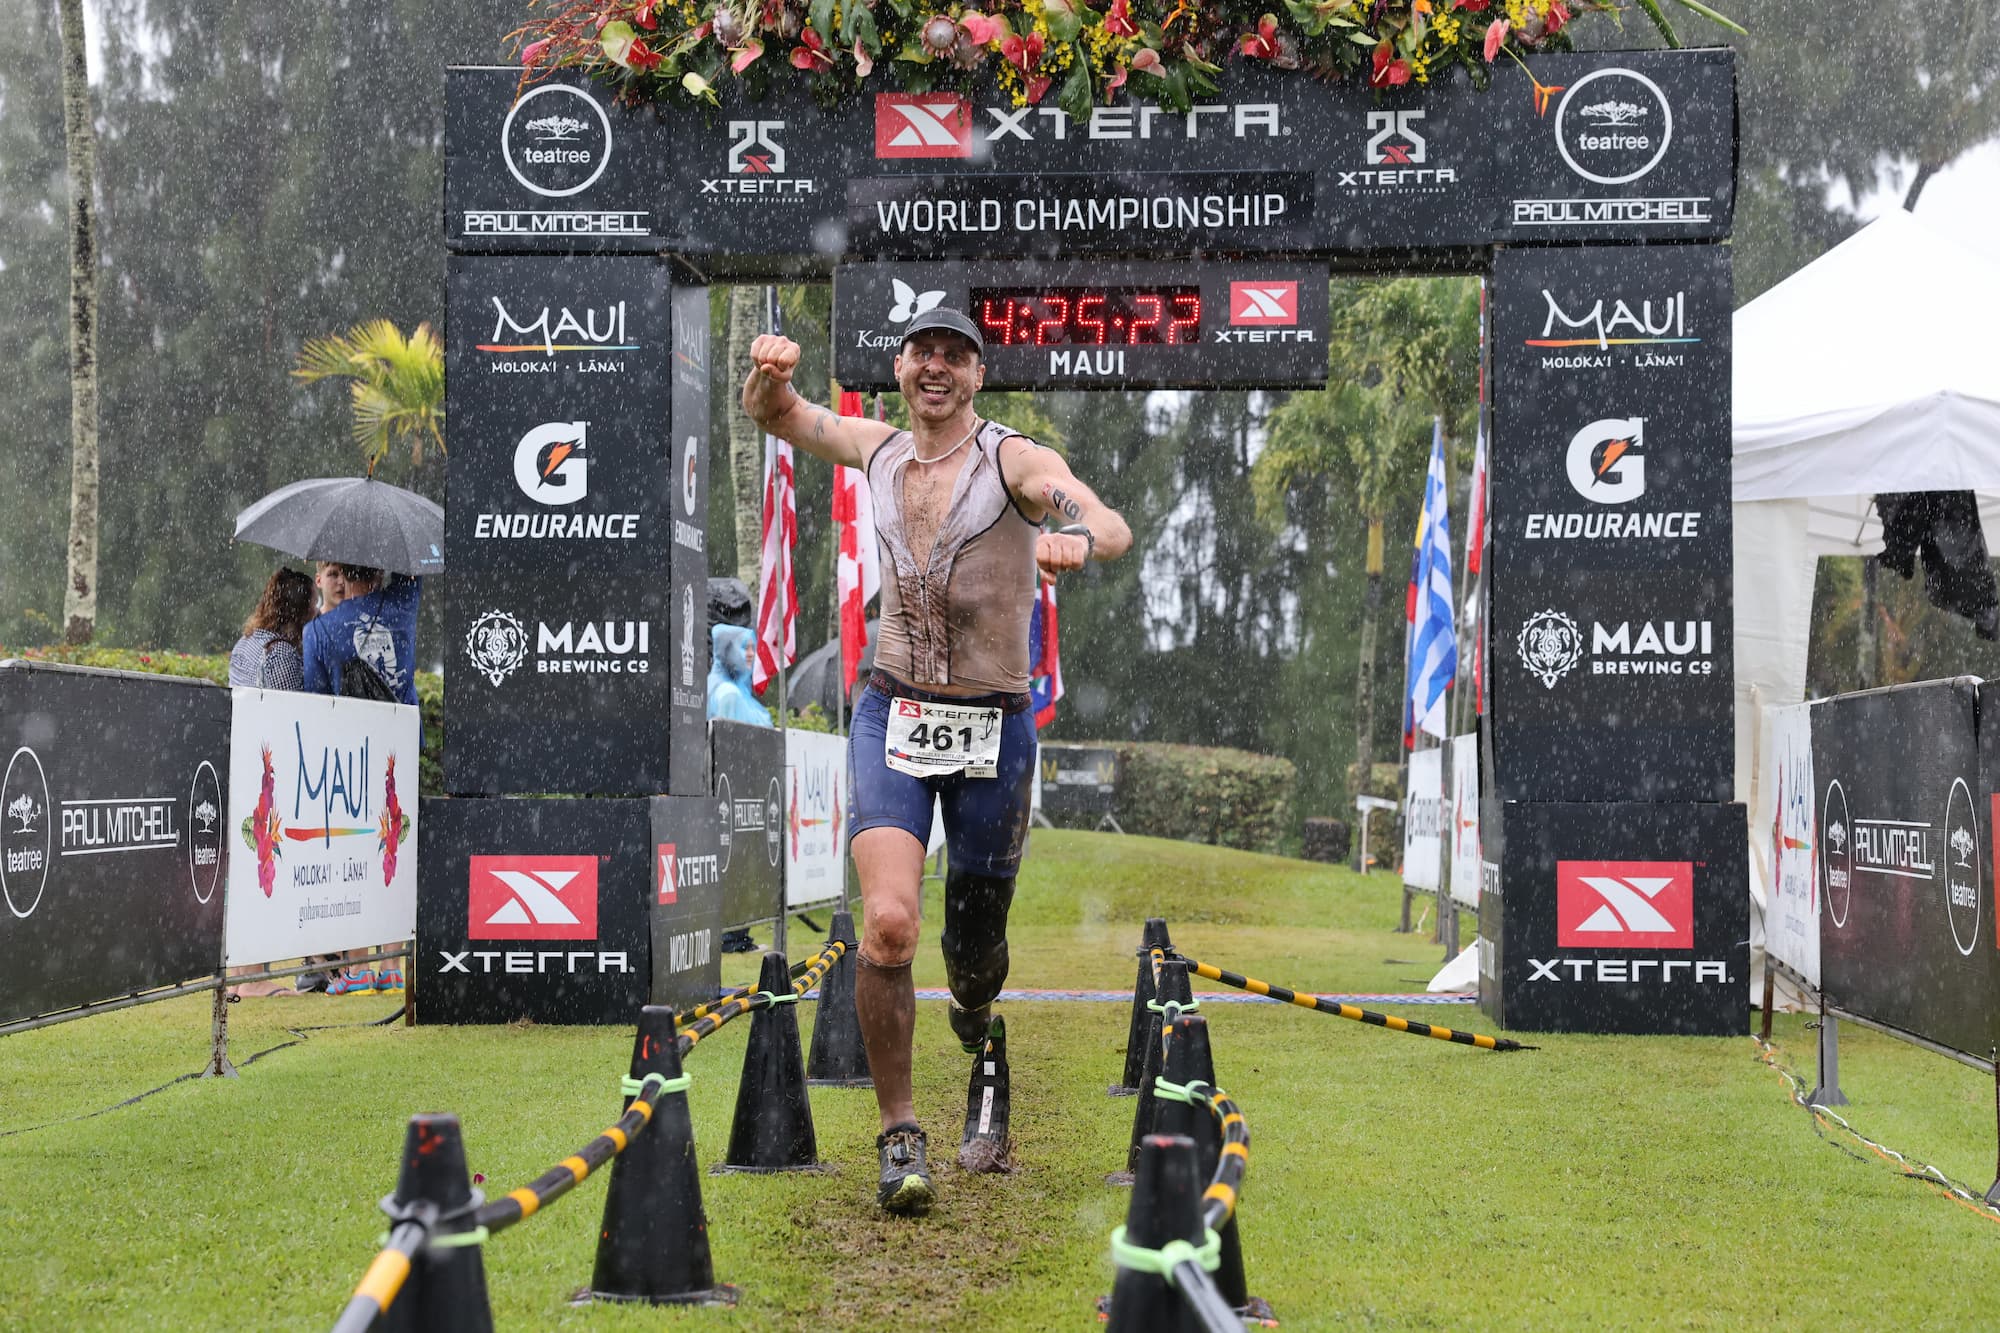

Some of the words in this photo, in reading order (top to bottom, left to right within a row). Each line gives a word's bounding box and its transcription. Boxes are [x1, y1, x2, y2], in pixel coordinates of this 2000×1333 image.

[728, 120, 786, 174] 25
[1366, 109, 1426, 165] 25
[1578, 132, 1650, 150] teatree
[524, 147, 591, 164] teatree
[700, 179, 813, 194] XTERRA
[1337, 168, 1456, 186] XTERRA
[464, 213, 528, 232] PAUL
[531, 214, 648, 232] MITCHELL
[877, 200, 1001, 232] WORLD
[1014, 193, 1286, 231] CHAMPIONSHIP
[1514, 203, 1580, 221] PAUL
[1584, 201, 1707, 220] MITCHELL
[491, 295, 626, 357] MAUI
[1541, 289, 1685, 351] MAUI
[855, 329, 905, 351] Kapa
[1214, 329, 1315, 344] XTERRA
[1050, 350, 1125, 376] MAUI
[1052, 488, 1081, 521] 46
[474, 514, 641, 539] ENDURANCE
[1524, 512, 1702, 540] ENDURANCE
[536, 621, 649, 654] MAUI
[1592, 620, 1712, 655] MAUI
[537, 660, 622, 674] BREWING
[1592, 661, 1682, 675] BREWING
[907, 722, 973, 752] 461
[295, 720, 369, 850] MAUI
[61, 808, 105, 847] PAUL
[105, 805, 177, 843] MITCHELL
[7, 847, 42, 873] teatree
[194, 843, 217, 866] teatree
[1855, 827, 1883, 863] PAUL
[1882, 828, 1932, 870] MITCHELL
[677, 854, 718, 888] XTERRA
[1829, 864, 1848, 889] teatree
[1951, 878, 1977, 909] teatree
[438, 951, 627, 973] XTERRA
[669, 931, 694, 975] WORLD
[694, 928, 711, 969] TOUR
[1527, 958, 1728, 983] XTERRA
